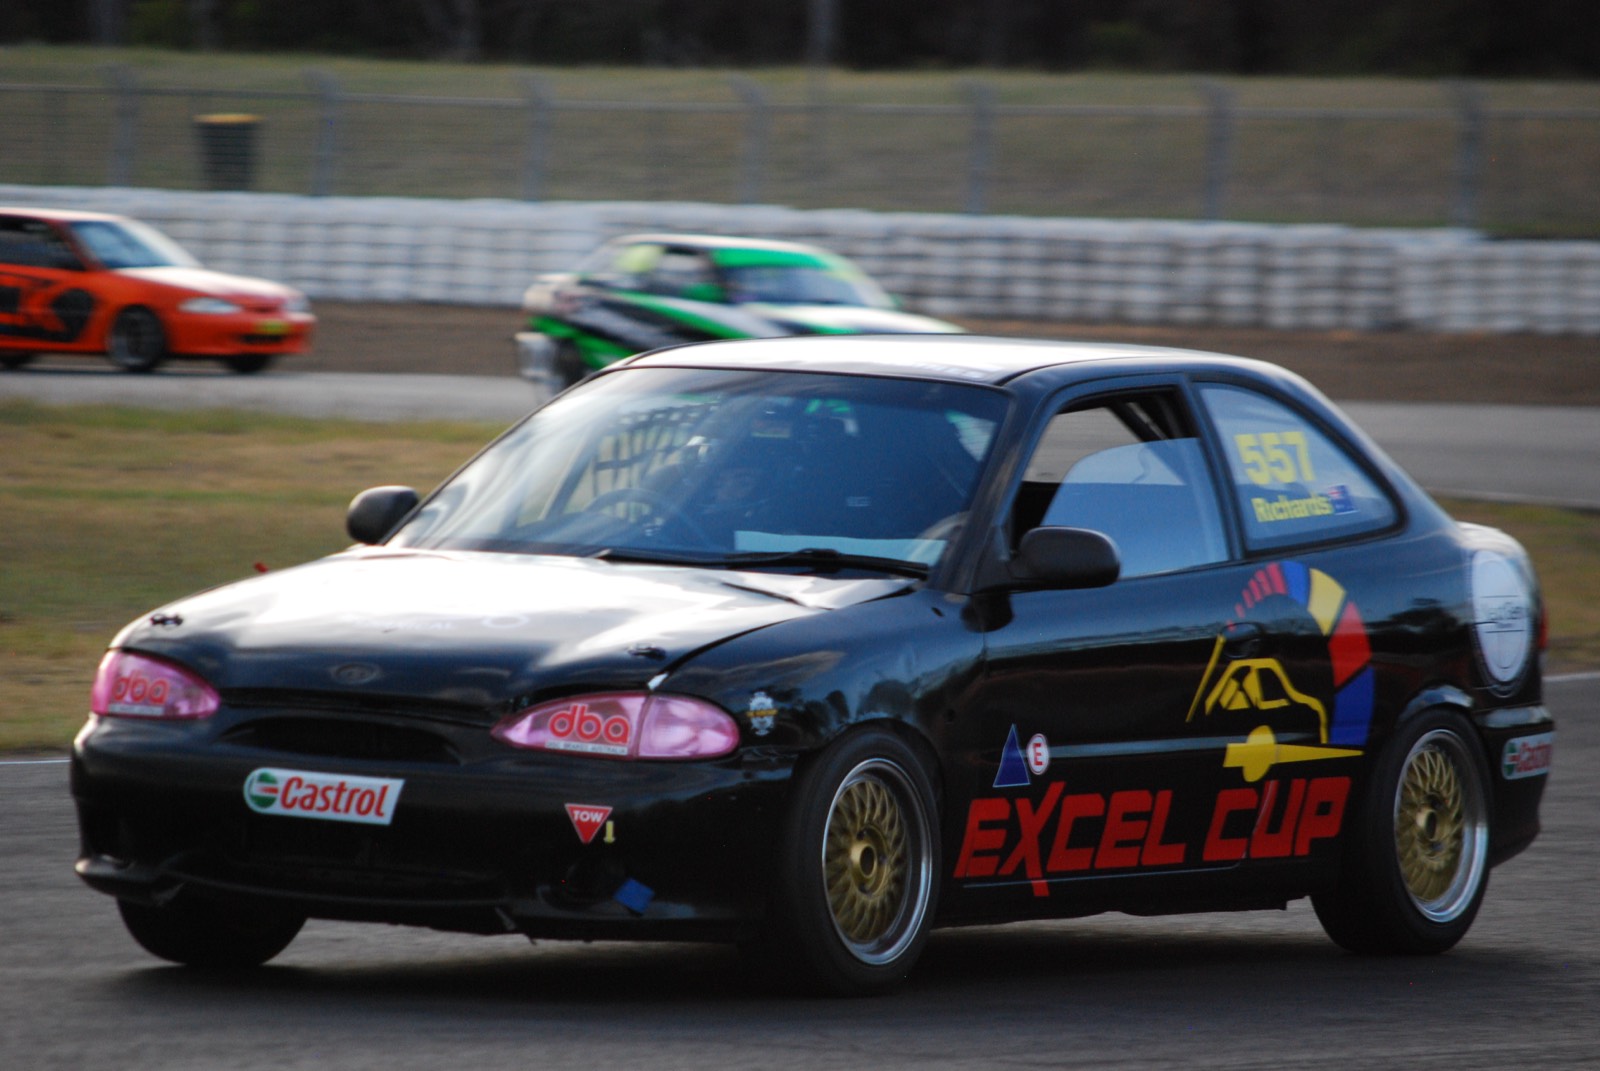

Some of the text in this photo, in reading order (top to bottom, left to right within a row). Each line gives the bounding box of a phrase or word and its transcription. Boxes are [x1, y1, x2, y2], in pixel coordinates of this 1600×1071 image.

[1235, 431, 1316, 485] 557
[1251, 490, 1334, 523] Richards
[548, 704, 630, 745] dba
[1033, 742, 1043, 766] E
[281, 776, 389, 818] Castrol
[573, 810, 604, 822] TOW
[953, 776, 1351, 896] EXCEL CUP
